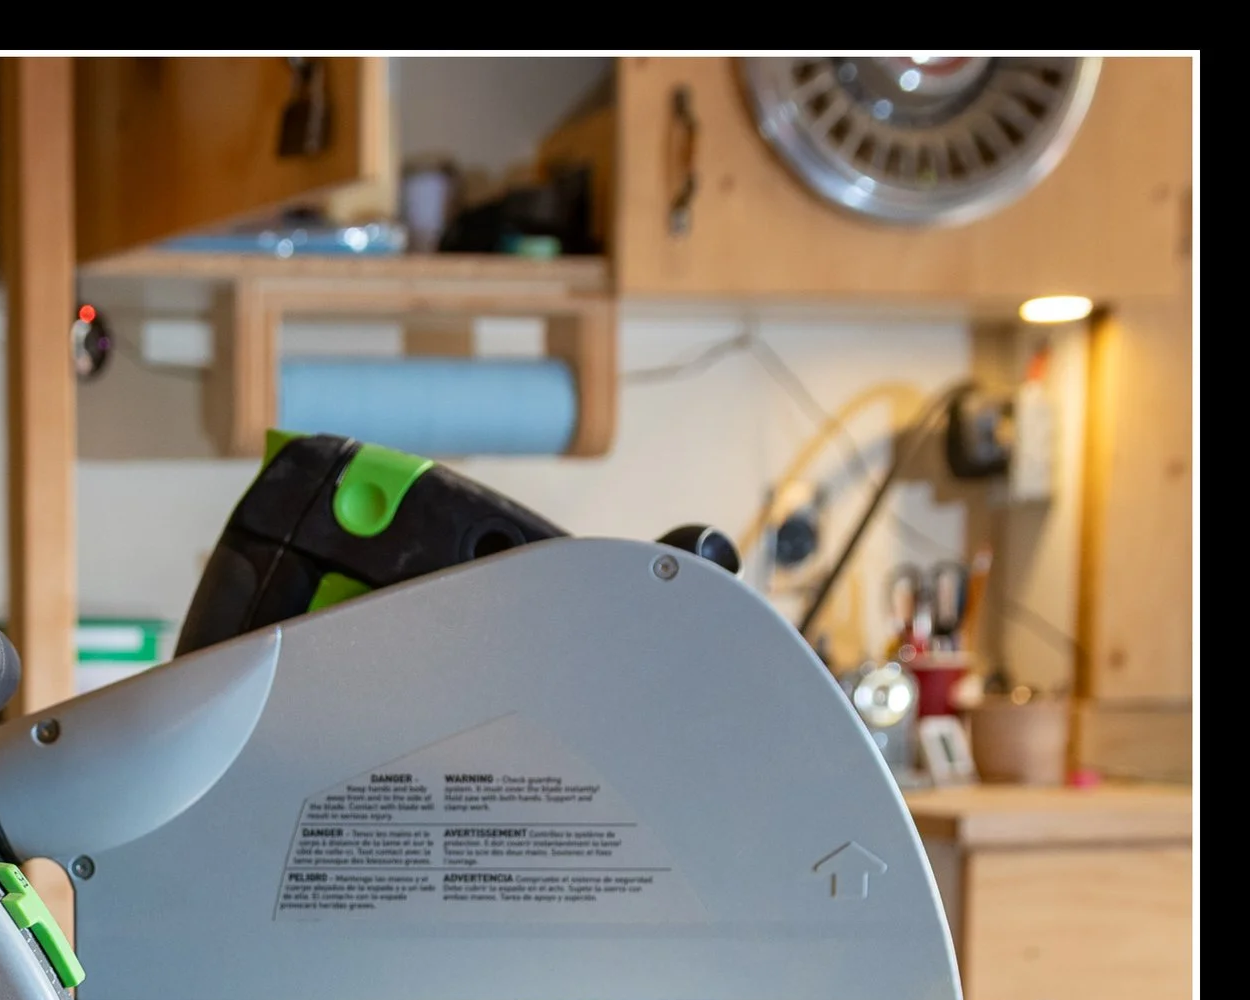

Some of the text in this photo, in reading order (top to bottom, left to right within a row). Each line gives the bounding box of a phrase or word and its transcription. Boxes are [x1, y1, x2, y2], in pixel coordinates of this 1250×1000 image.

[371, 774, 413, 783] DANGER
[444, 774, 494, 783] WARNING
[302, 828, 343, 837] DANGER
[443, 828, 528, 838] AVERTISSEMENT
[443, 873, 514, 883] ADVERTENCIA
